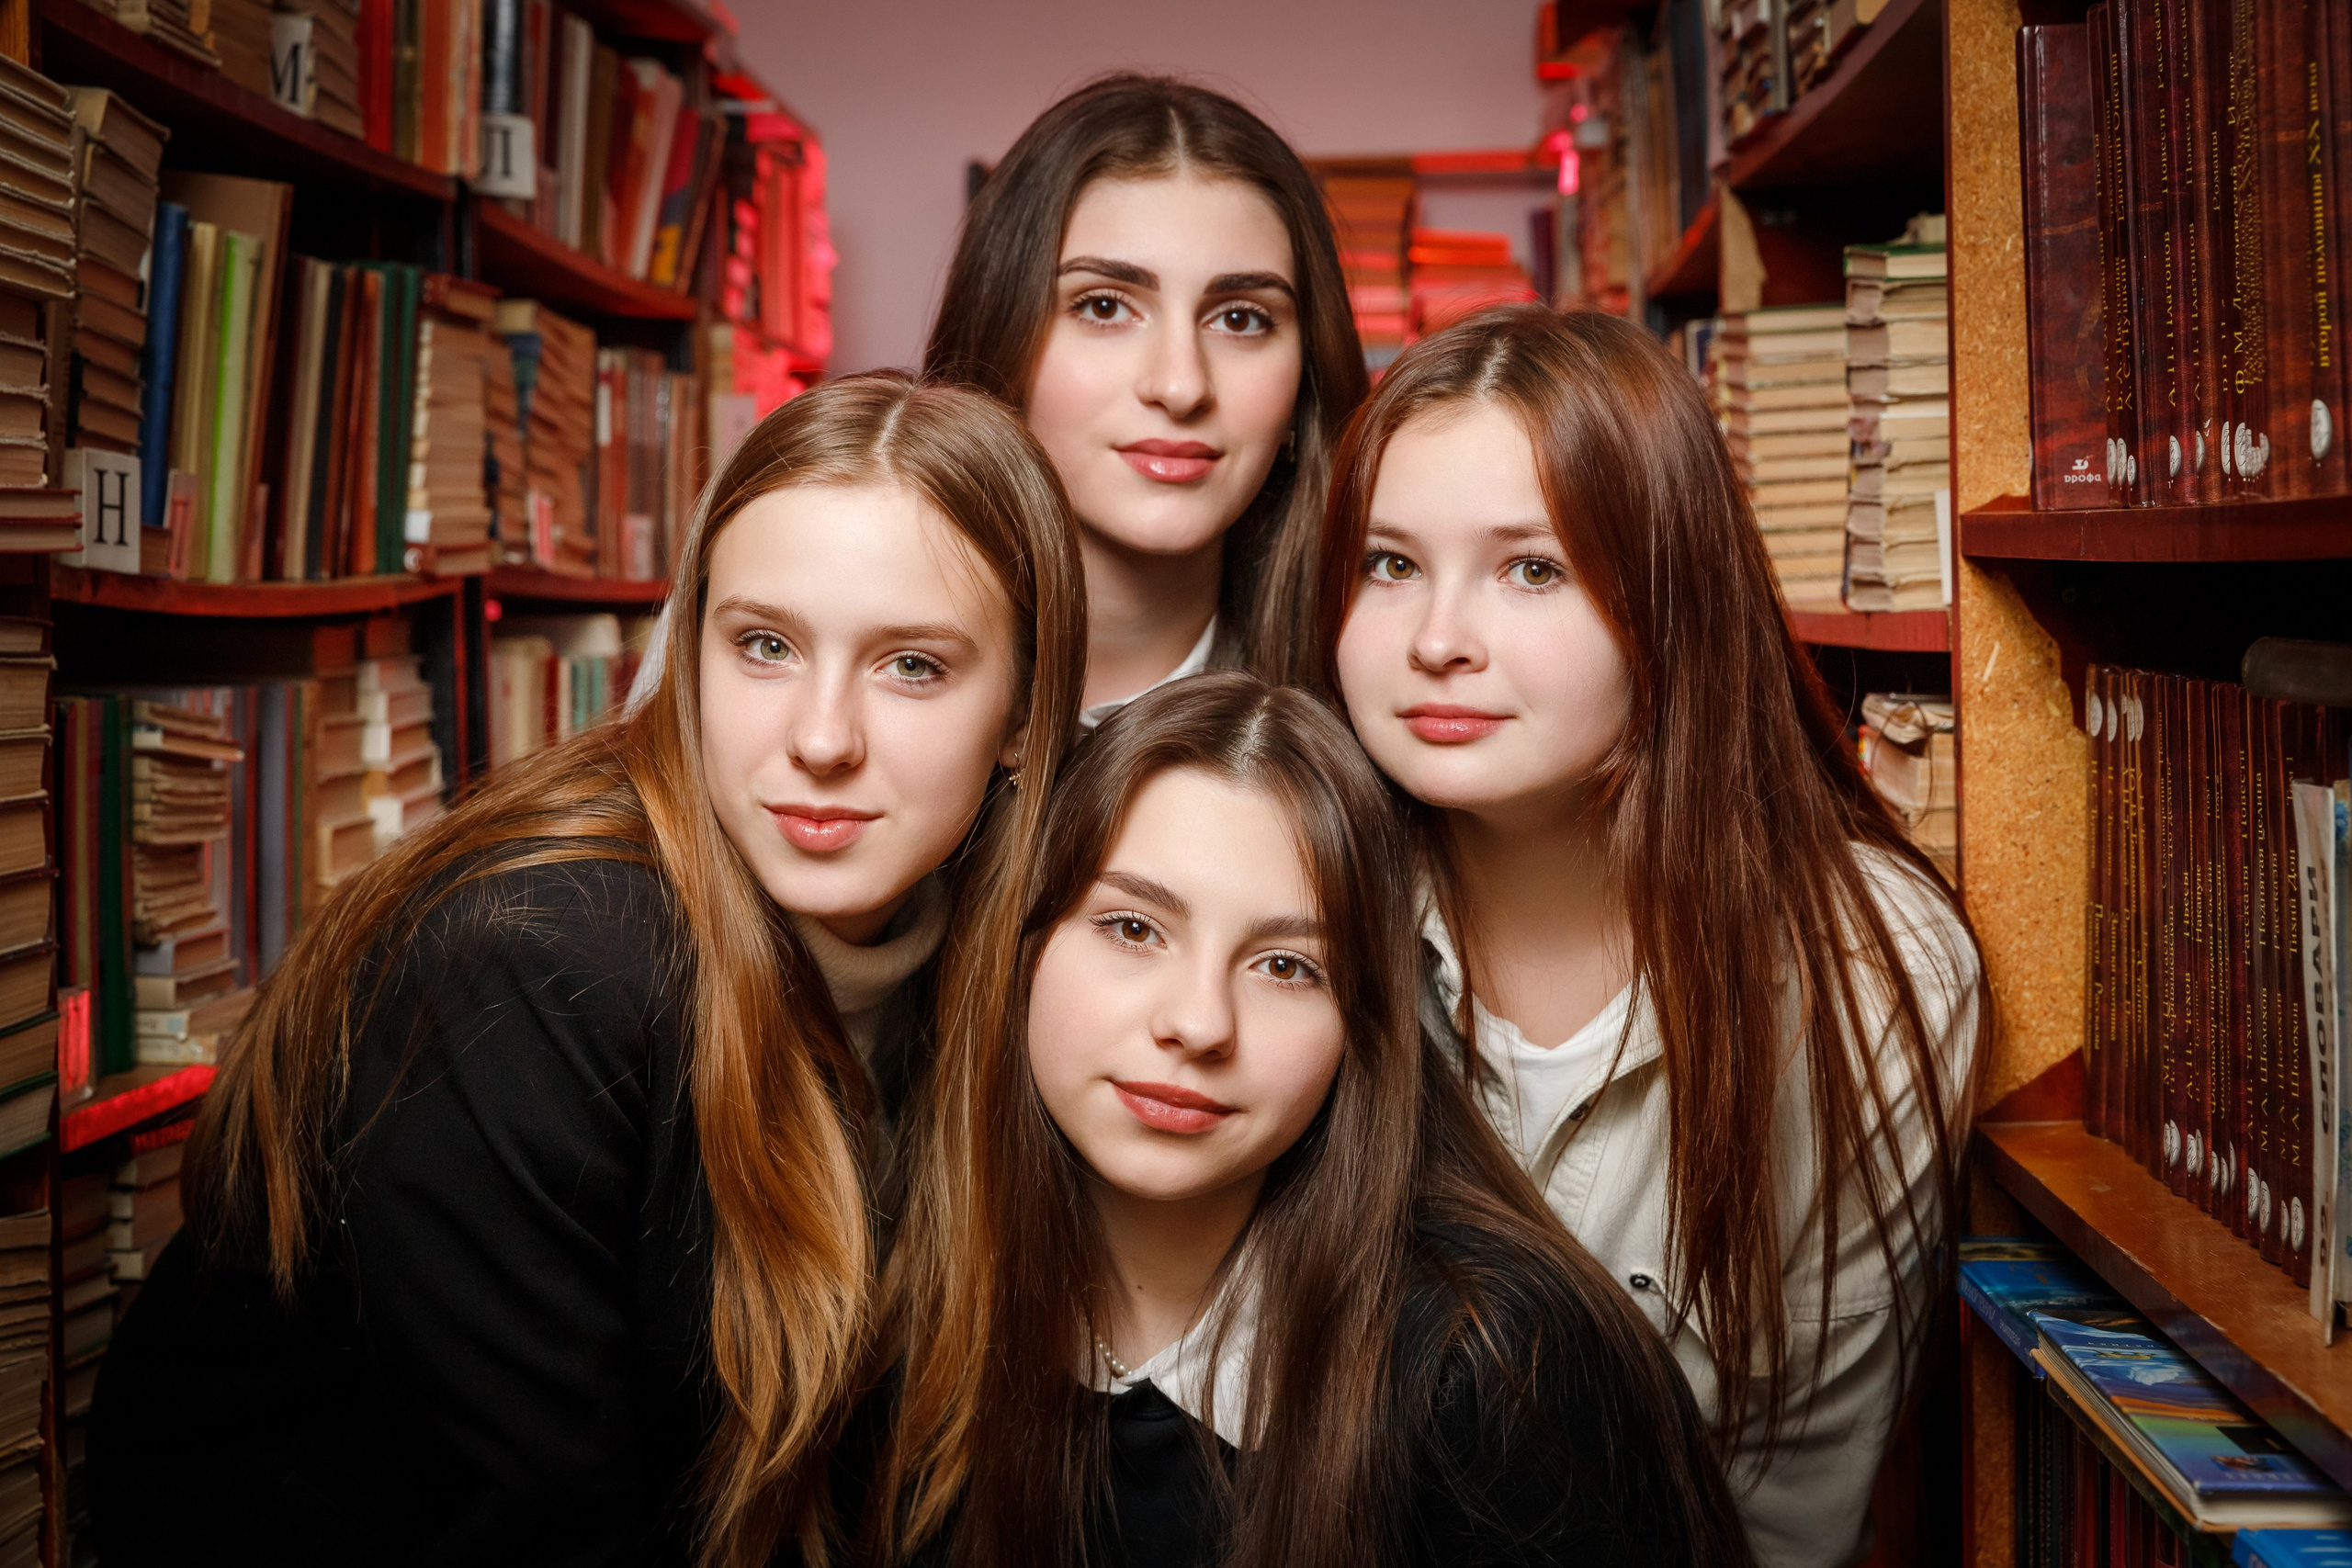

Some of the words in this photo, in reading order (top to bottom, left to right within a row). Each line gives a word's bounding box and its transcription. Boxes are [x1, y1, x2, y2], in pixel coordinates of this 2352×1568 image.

[2111, 52, 2120, 130] Онегин
[2308, 62, 2319, 111] века
[2159, 107, 2168, 194] Повести
[2183, 96, 2194, 186] Повести
[2211, 130, 2220, 211] Романы
[2115, 136, 2124, 220] Евгений
[2312, 174, 2327, 283] половины
[2120, 258, 2131, 345] Пушкин
[2164, 231, 2174, 338] Платонов
[2188, 222, 2199, 331] Платонов
[2313, 291, 2332, 367] второй
[2122, 355, 2131, 378] С.
[2124, 386, 2132, 410] А.
[2168, 381, 2176, 407] А.
[2194, 376, 2200, 400] А.
[93, 467, 130, 547] Н
[2239, 750, 2247, 840] Повести
[2256, 772, 2266, 840] целина
[2272, 852, 2280, 950] Рассказы
[2288, 849, 2297, 891] Дон
[2243, 865, 2251, 966] Рассказы
[2289, 898, 2298, 959] Тихий
[2162, 924, 2171, 1018] Цветаева
[2184, 971, 2192, 1033] Чехов
[2307, 865, 2329, 1134] СЛОВАРИ
[2290, 1001, 2299, 1098] Шолохов
[2186, 1075, 2192, 1100] А.
[2260, 1093, 2267, 1117] А.
[2278, 1100, 2285, 1123] А.
[2291, 1108, 2299, 1131] А.
[2246, 1114, 2253, 1141] А.
[2260, 1124, 2267, 1152] М.
[2279, 1132, 2286, 1160] М.
[2291, 1139, 2301, 1167] М.
